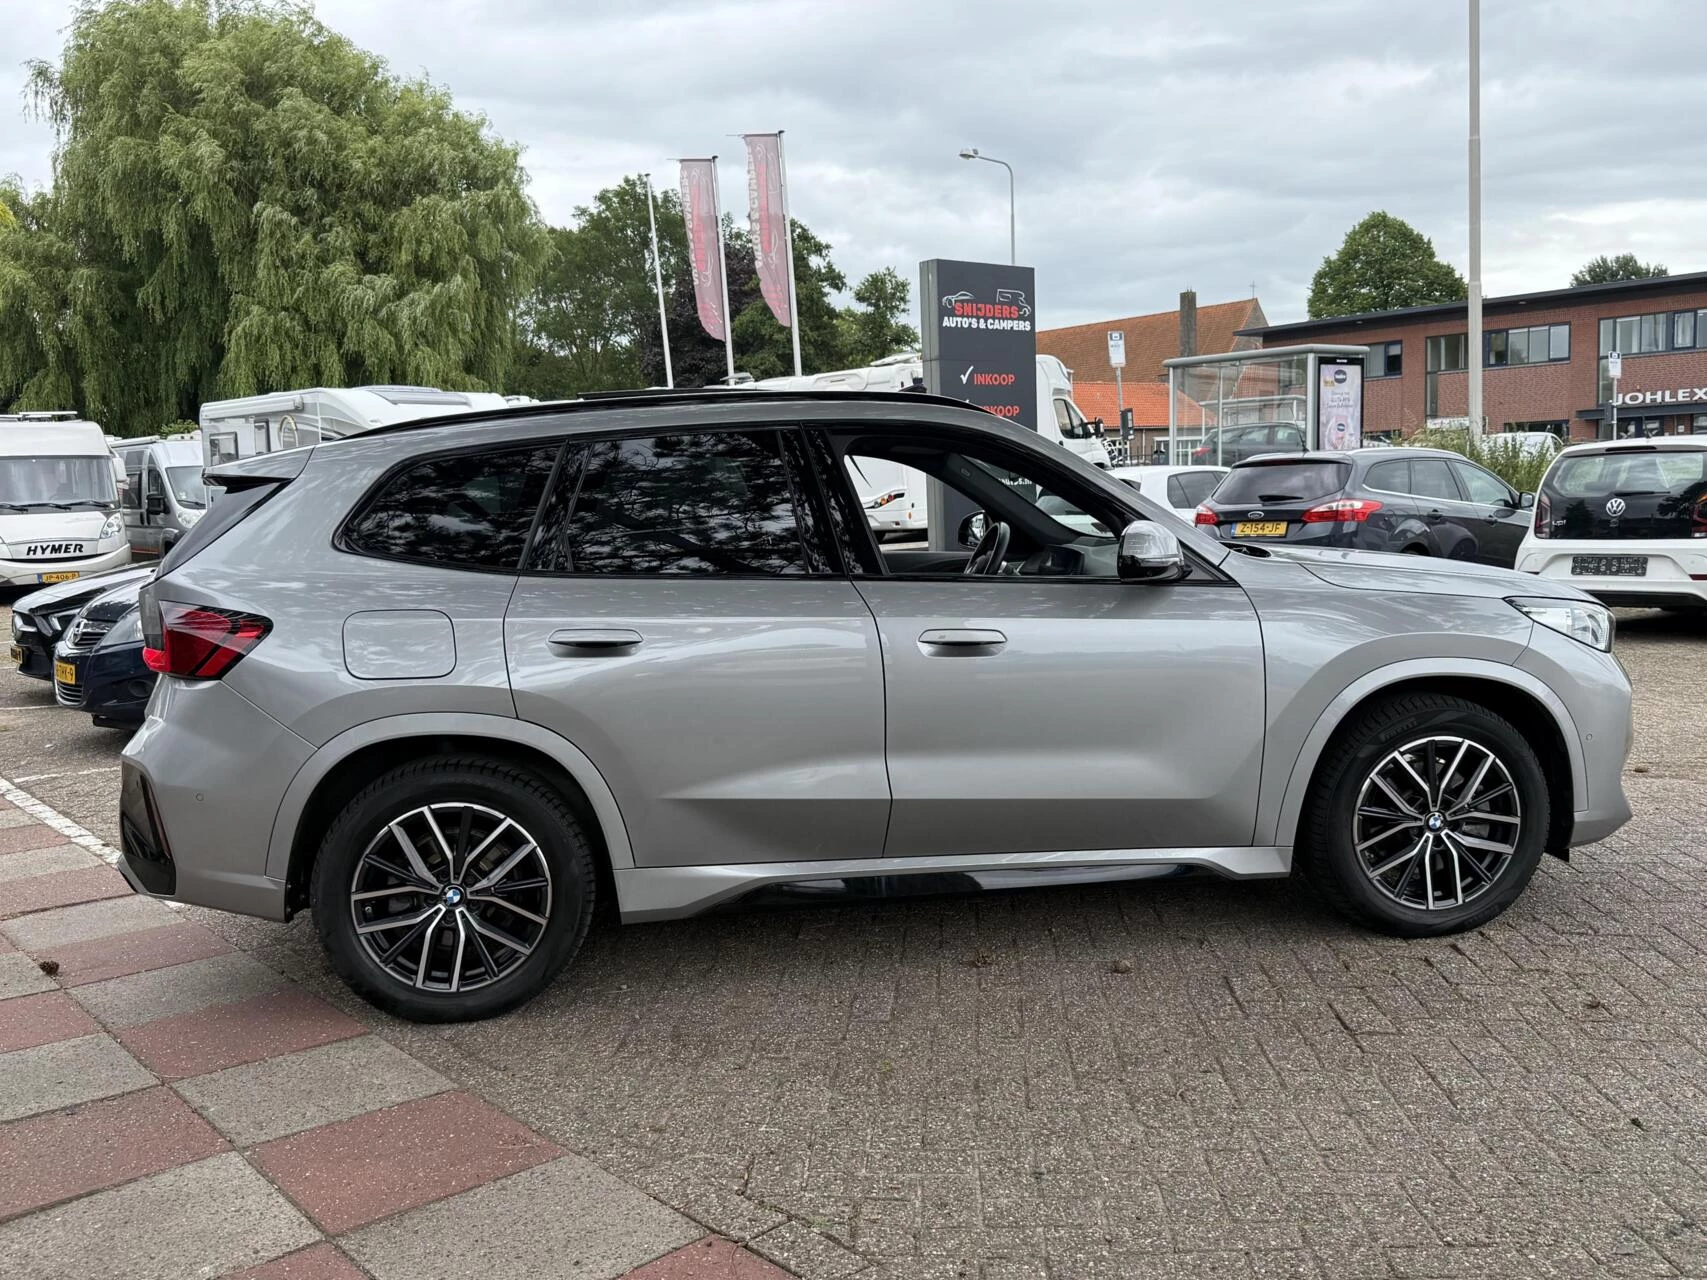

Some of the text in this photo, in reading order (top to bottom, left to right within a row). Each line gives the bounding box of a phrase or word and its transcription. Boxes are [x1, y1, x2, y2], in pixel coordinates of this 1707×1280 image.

[954, 302, 1019, 319] SNIJDERS
[942, 316, 1032, 331] AUTO'S & CAMPERS
[973, 373, 1015, 385] INKOOP
[1612, 387, 1707, 405] JOHLEX
[1240, 523, 1281, 533] Z-154-JF
[26, 543, 84, 556] HYMER
